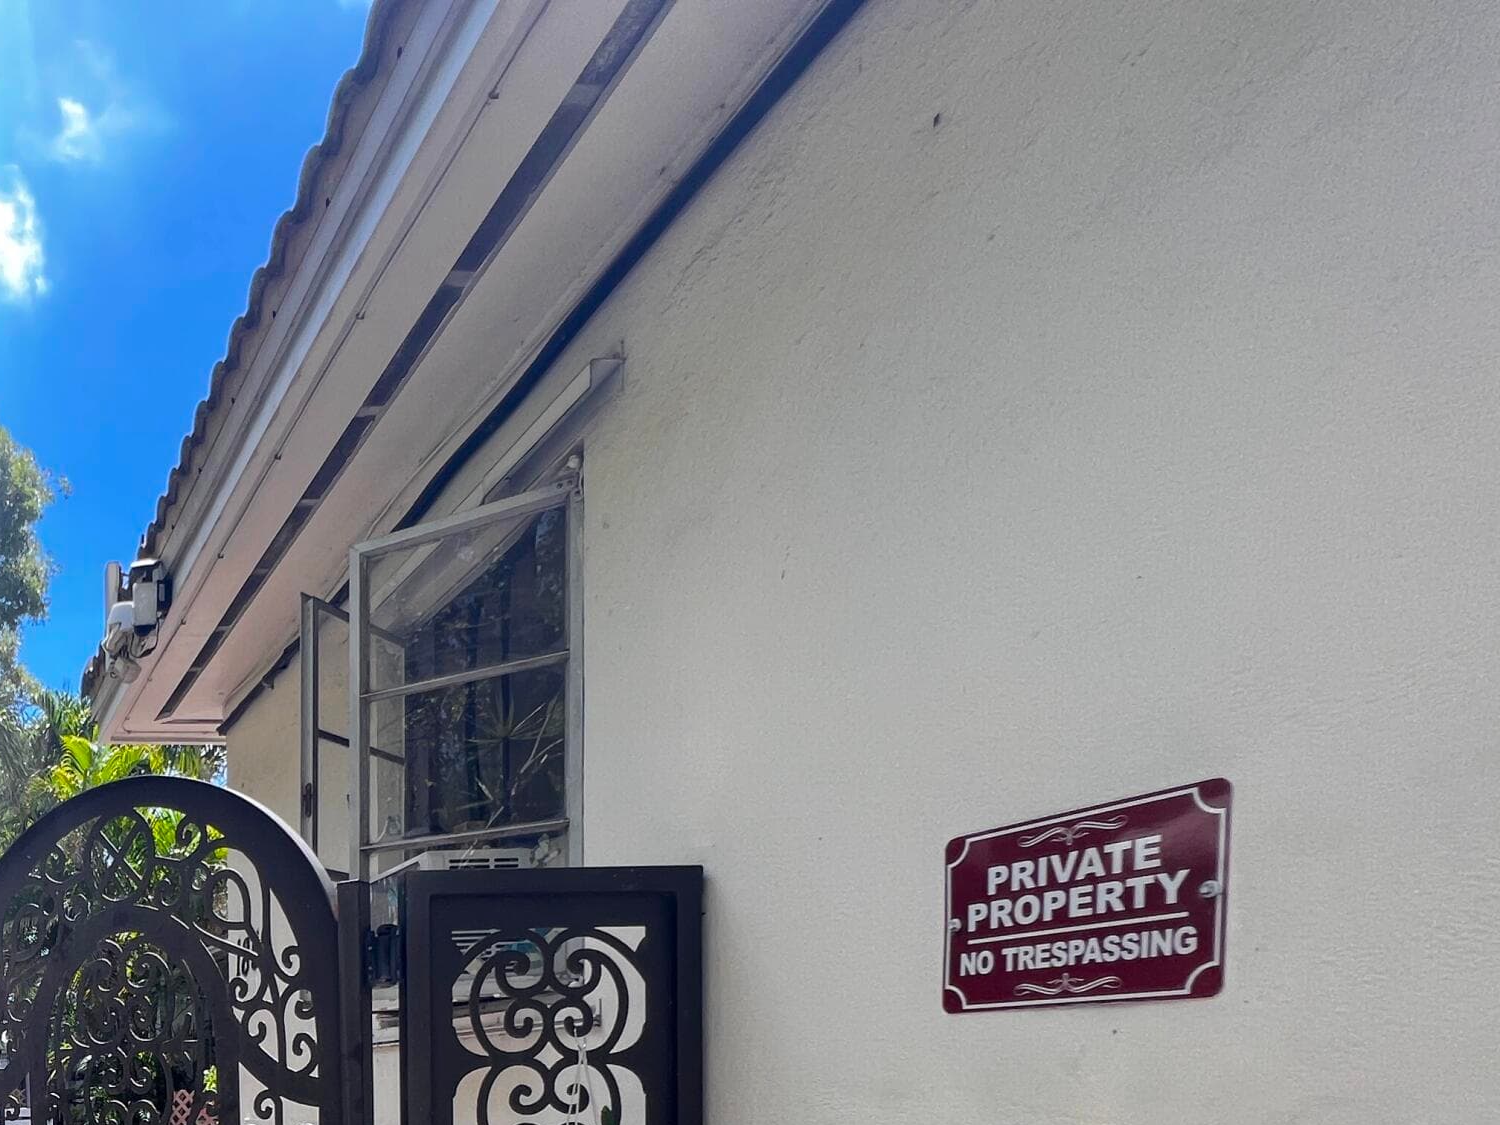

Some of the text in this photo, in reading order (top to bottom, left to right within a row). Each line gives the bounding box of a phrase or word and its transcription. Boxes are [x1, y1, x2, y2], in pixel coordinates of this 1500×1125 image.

[987, 835, 1162, 895] PRIVATE
[967, 869, 1190, 932] PROPERTY
[959, 926, 1198, 976] NO TRESPASSING
